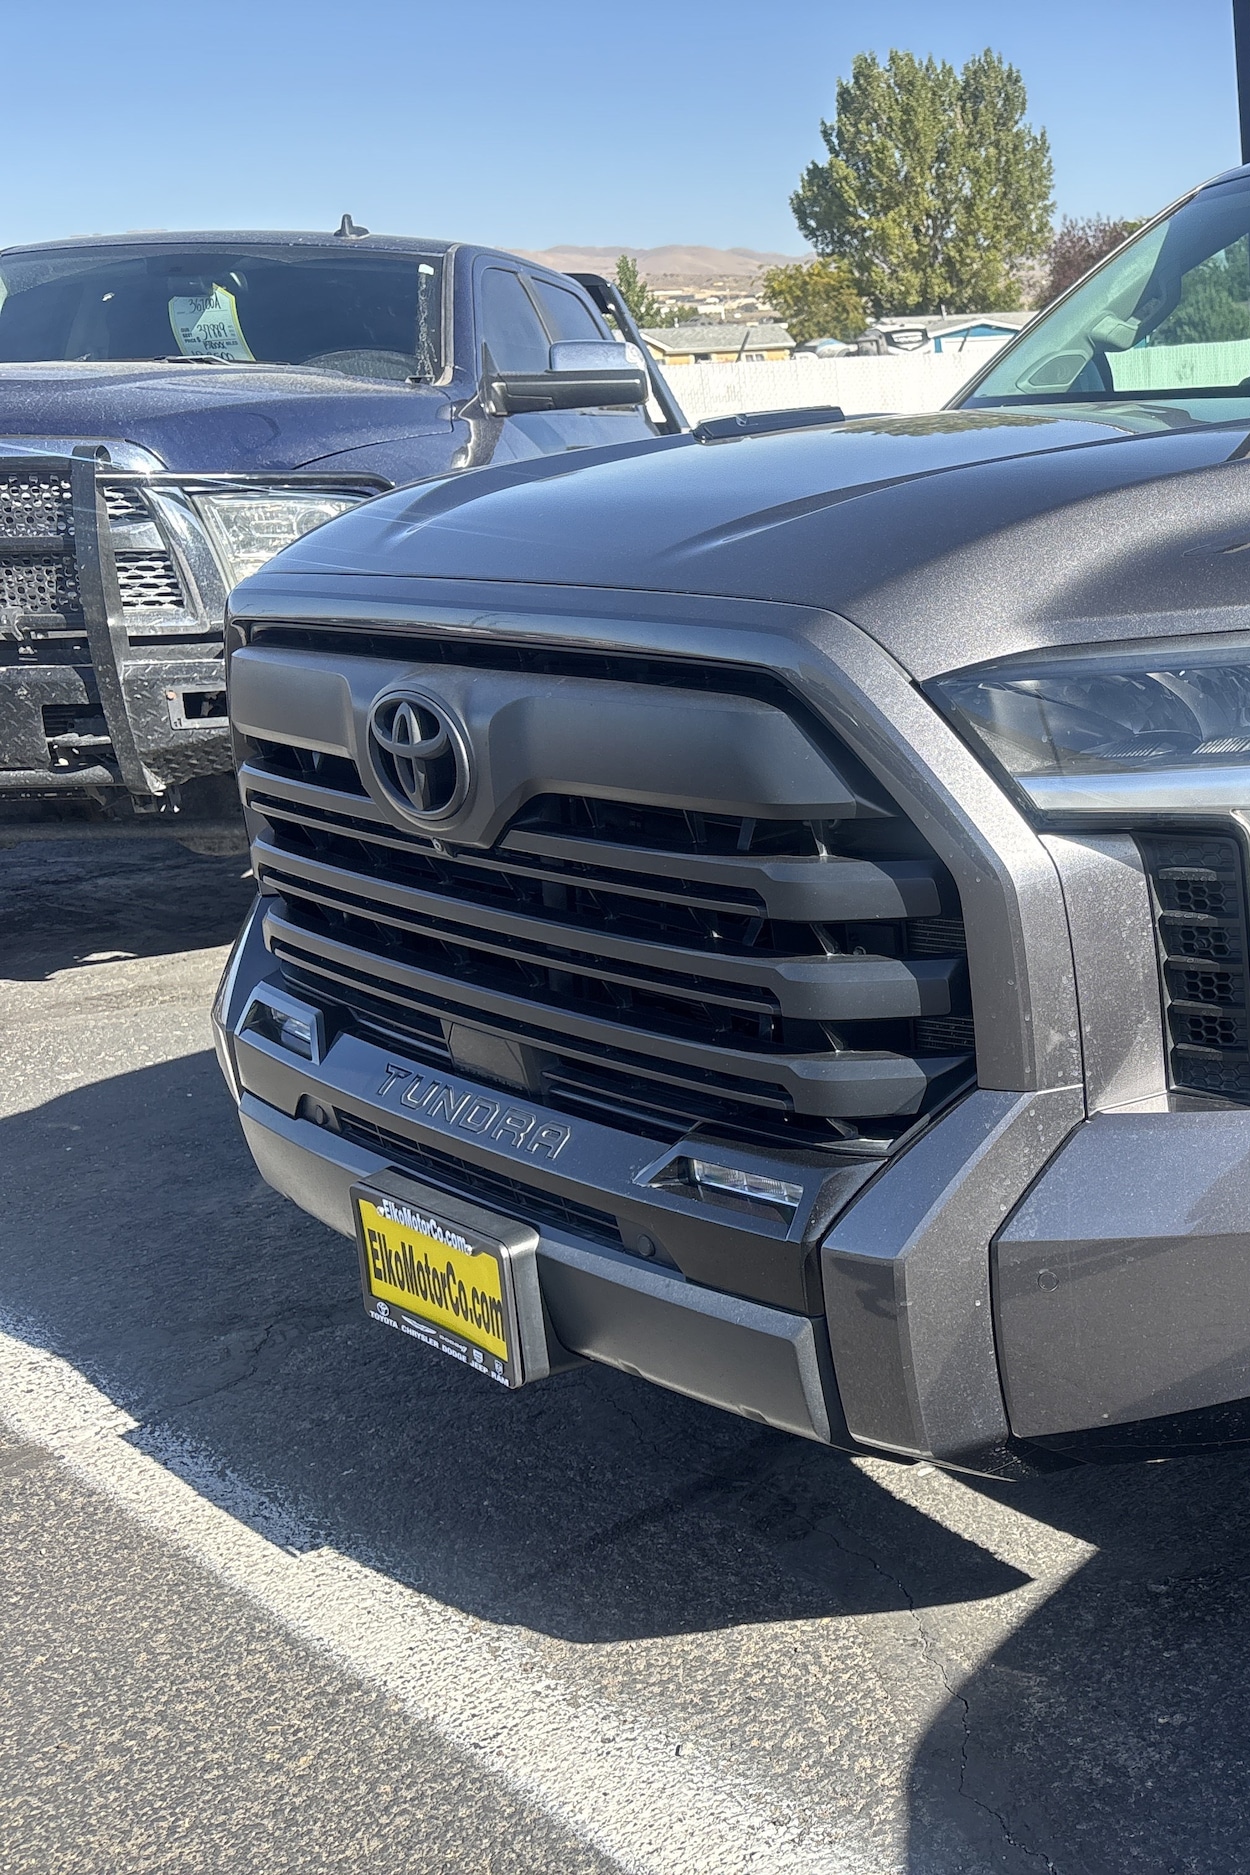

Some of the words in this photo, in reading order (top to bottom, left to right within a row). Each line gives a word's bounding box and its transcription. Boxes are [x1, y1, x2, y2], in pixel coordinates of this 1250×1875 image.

[376, 1063, 571, 1160] TUNDRA
[382, 1199, 467, 1252] ElkoMotorCo.com
[367, 1228, 506, 1342] ElkoMotorCo.com
[369, 1310, 399, 1329] TOYOTA
[401, 1324, 439, 1349] CHRYSLER
[441, 1344, 467, 1363] DODGE
[469, 1360, 489, 1374] JEEP
[491, 1371, 509, 1387] RAM
